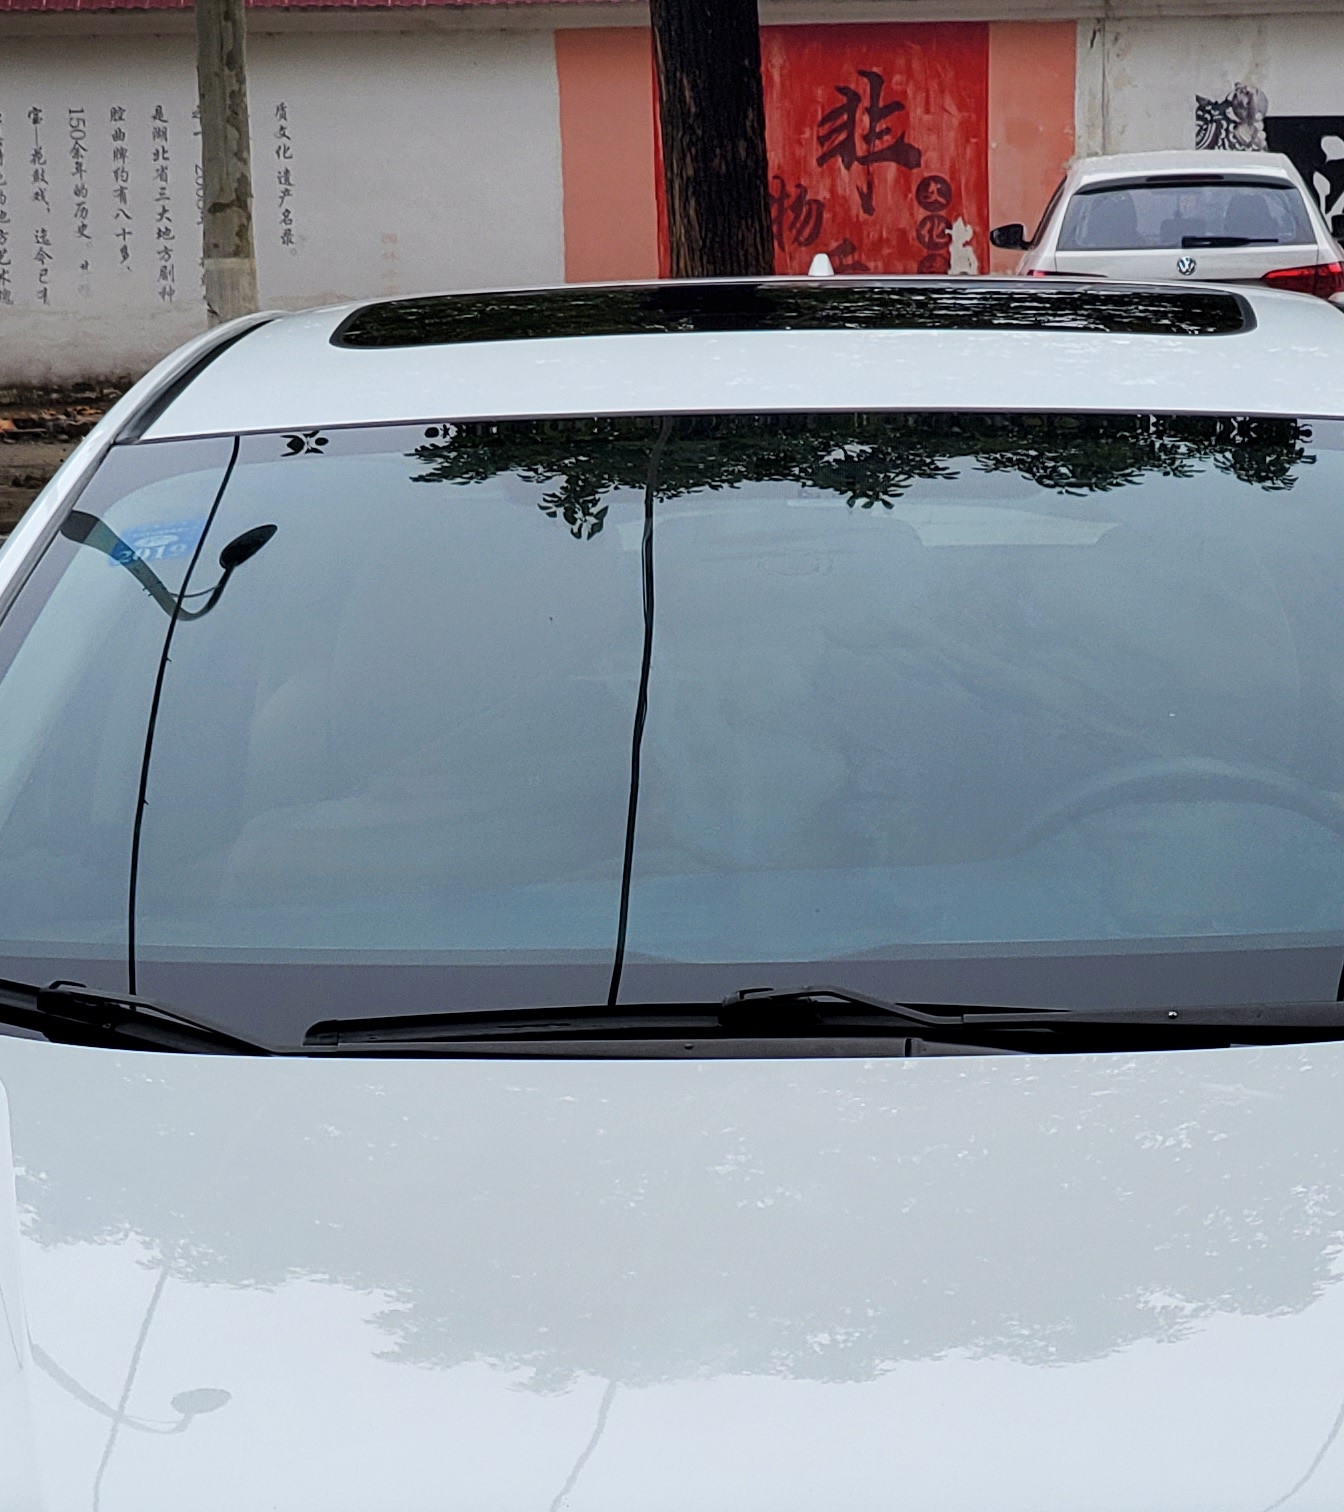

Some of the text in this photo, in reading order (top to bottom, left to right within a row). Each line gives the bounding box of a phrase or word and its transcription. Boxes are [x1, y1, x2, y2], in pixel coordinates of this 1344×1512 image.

[151, 105, 175, 303] 是湖北省三大地方剧种
[816, 70, 922, 216] 非
